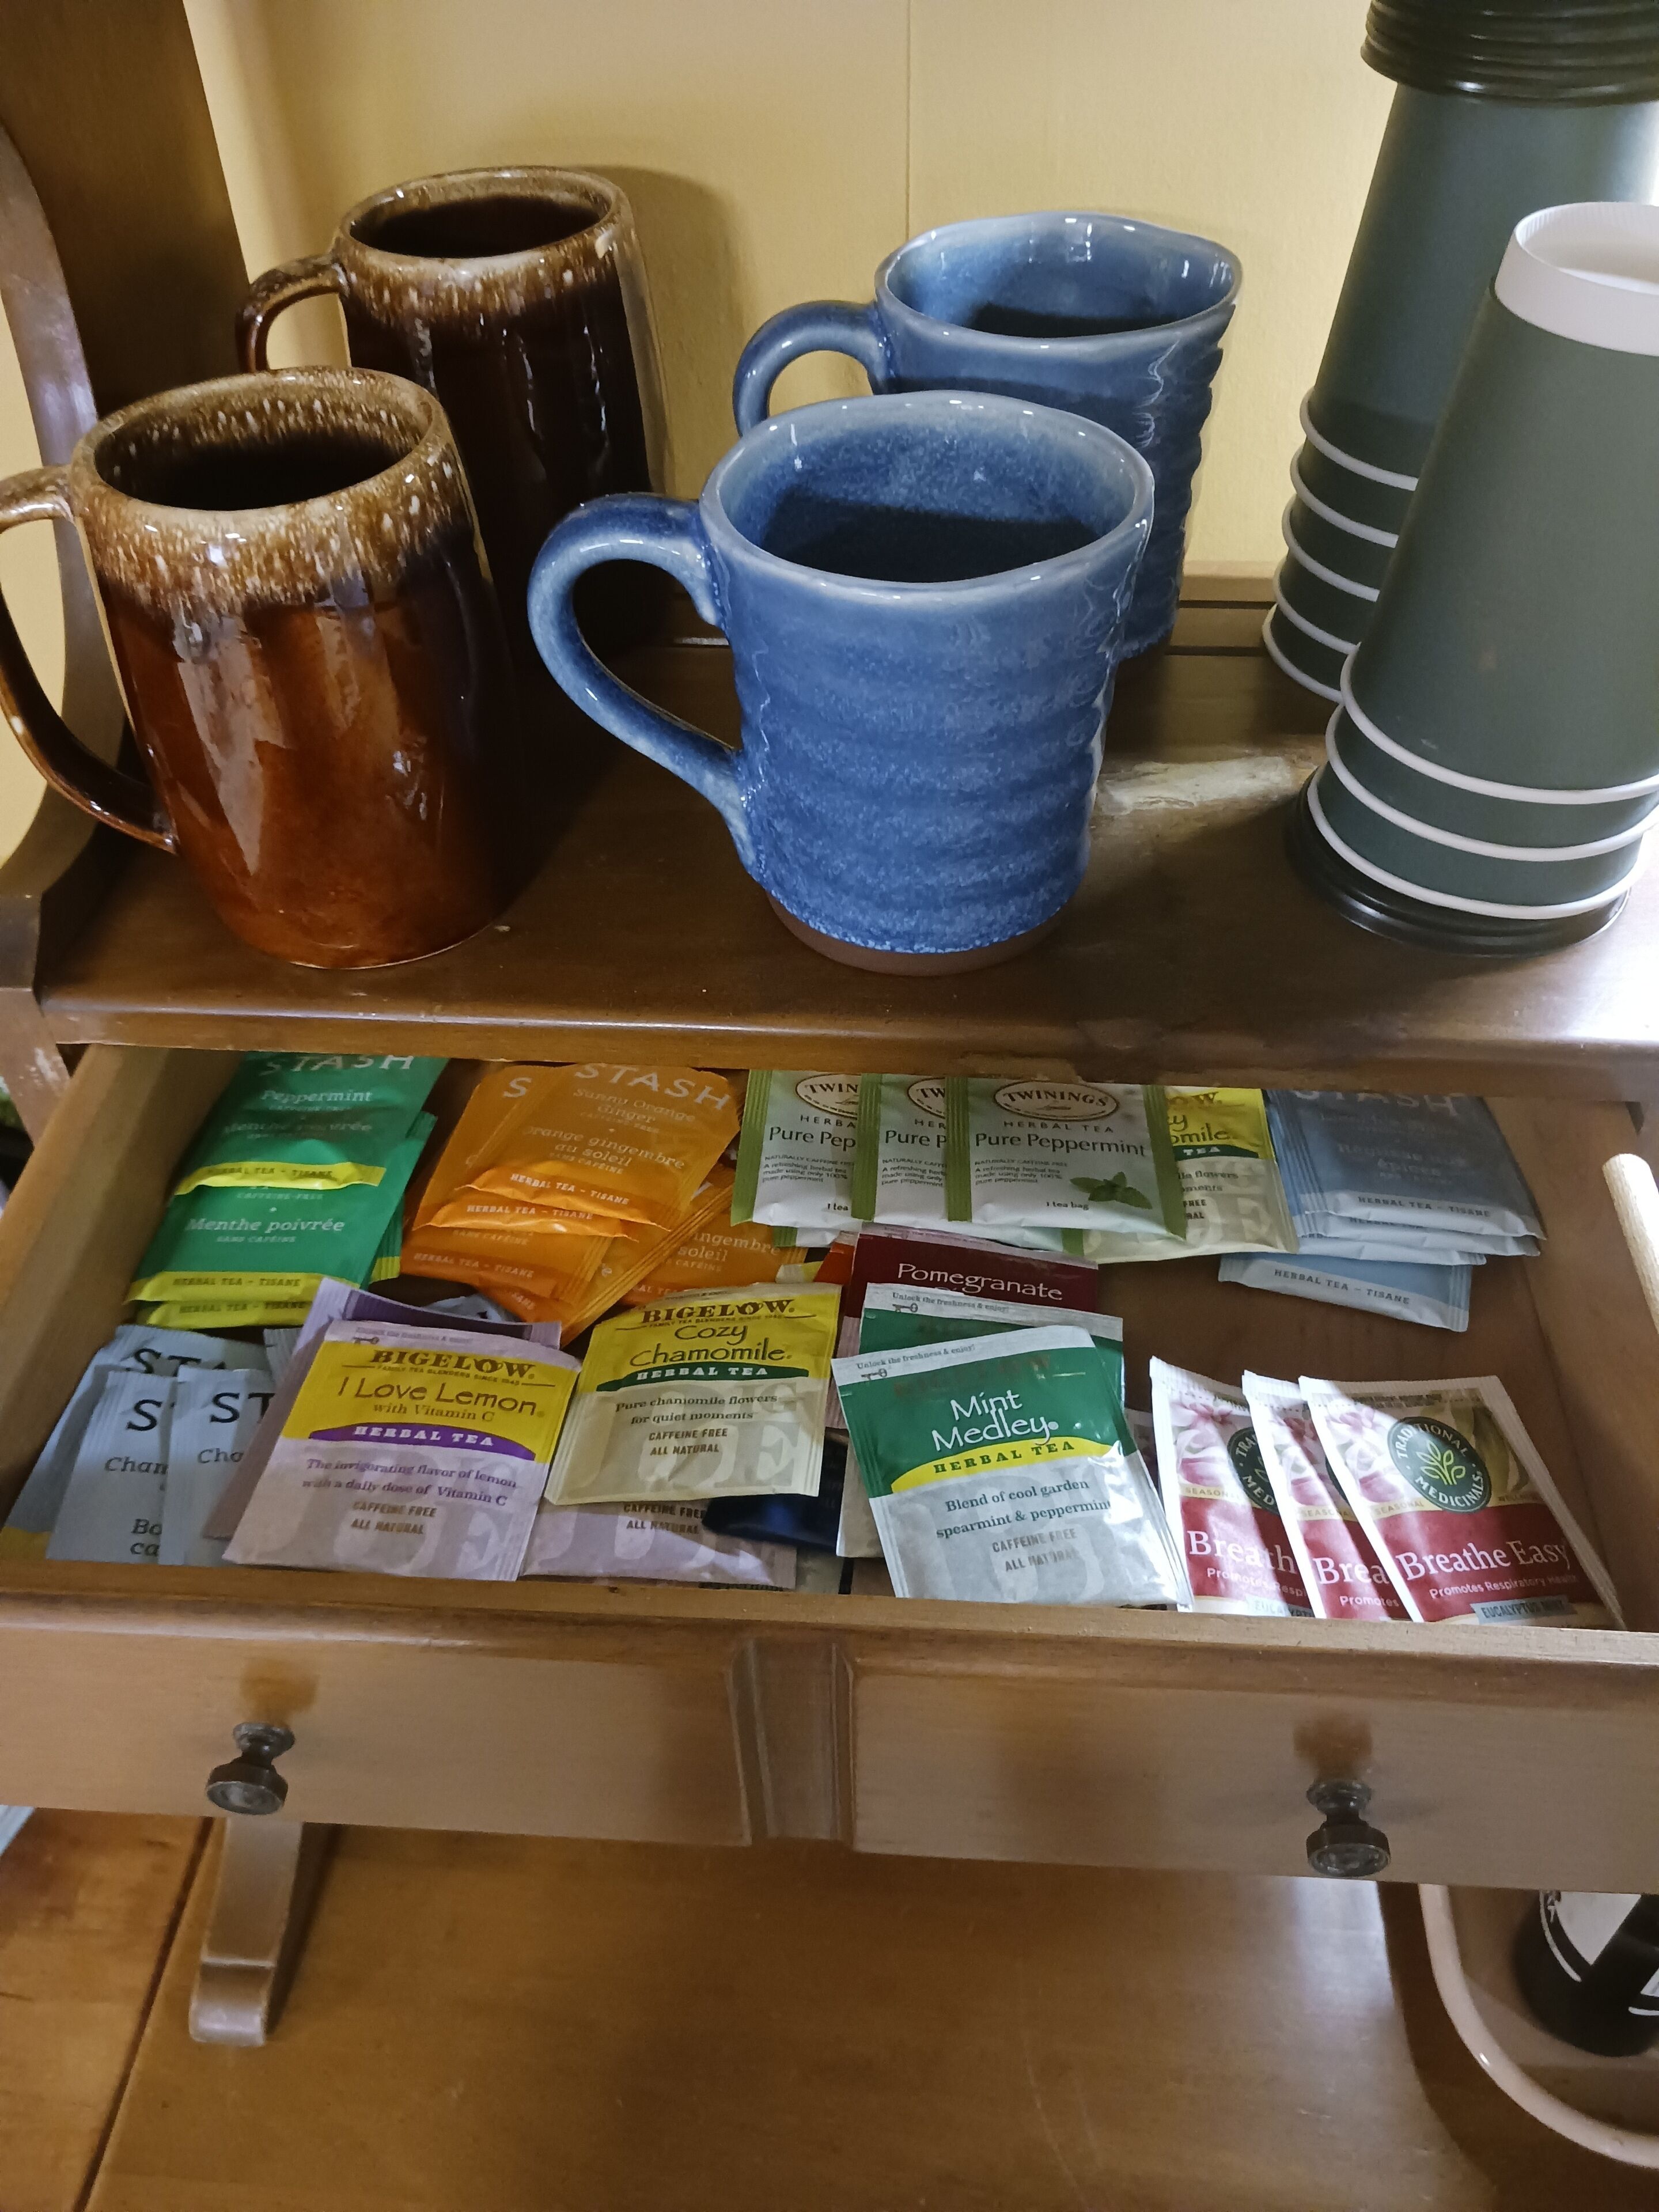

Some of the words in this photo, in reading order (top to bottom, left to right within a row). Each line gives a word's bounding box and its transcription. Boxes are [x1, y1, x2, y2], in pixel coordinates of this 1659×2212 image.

[574, 1063, 731, 1110] STASH
[805, 1083, 858, 1093] TWIN
[1003, 1090, 1109, 1106] TWININGS
[597, 1105, 656, 1123] Ginger
[634, 1100, 696, 1123] Orange
[801, 1115, 856, 1128] HERBA
[915, 1119, 946, 1130] HER
[1004, 1121, 1072, 1130] HERBAL
[1082, 1124, 1113, 1133] TEA
[769, 1127, 814, 1143] Pure
[886, 1130, 930, 1146] Pure
[589, 1137, 685, 1170] gingembre
[976, 1133, 1021, 1146] Pure
[1028, 1133, 1145, 1157] Peppermint
[1183, 1146, 1220, 1156] TEA
[555, 1142, 577, 1153] au
[582, 1148, 632, 1166] soleil
[891, 1166, 926, 1174] refreshing
[1195, 1171, 1238, 1179] flowers
[510, 1173, 550, 1189] HERBAL
[556, 1182, 575, 1192] TEA
[590, 1190, 630, 1205] TISANE
[901, 1179, 943, 1187] peppermint
[1071, 1201, 1089, 1210] bag
[1183, 1199, 1207, 1207] FREE
[1358, 1196, 1403, 1206] HERBAL
[1411, 1202, 1432, 1210] TEA
[467, 1205, 510, 1214] HERBAL
[516, 1206, 535, 1215] TEA
[553, 1209, 593, 1220] TISANE
[185, 1218, 262, 1230] Menthe
[264, 1218, 344, 1233] poivrée
[693, 1233, 780, 1256] ingembre
[677, 1246, 728, 1263] soleil
[460, 1259, 479, 1267] TEA
[495, 1264, 534, 1279] TISANE
[898, 1263, 1063, 1301] Pomegranate
[1274, 1269, 1321, 1284] HERBAL
[1327, 1280, 1348, 1290] TEA
[1366, 1289, 1410, 1304] TISANE
[893, 1293, 919, 1302] Unlock
[937, 1299, 975, 1309] freshness
[675, 1325, 748, 1345] Cozy
[856, 1359, 887, 1370] Unlock
[888, 1356, 902, 1364] the
[903, 1350, 942, 1362] freshness
[637, 1367, 718, 1380] HERBAL
[728, 1367, 768, 1375] TEA
[338, 1376, 349, 1396] I
[355, 1378, 427, 1400] Love
[616, 1400, 647, 1412] Pure
[650, 1397, 726, 1406] chamomile
[729, 1395, 778, 1404] flowers
[950, 1389, 1022, 1421] Mint
[374, 1403, 407, 1414] with
[415, 1404, 476, 1419] Vitamin
[482, 1411, 495, 1422] C
[631, 1416, 650, 1425] for
[653, 1412, 686, 1423] quiet
[354, 1426, 441, 1440] HERBAL
[452, 1433, 494, 1445] TEA
[649, 1430, 698, 1441] CAFFEINE
[702, 1429, 728, 1437] FREE
[1397, 1423, 1468, 1459] TRADITIONAL
[650, 1446, 668, 1456] ALL
[673, 1444, 719, 1454] NATURAL
[933, 1450, 1022, 1474] HERBAL
[1031, 1441, 1075, 1456] TEA
[307, 1459, 329, 1469] The
[334, 1460, 414, 1475] invigorating
[417, 1465, 459, 1477] flavor
[459, 1469, 472, 1479] of
[475, 1470, 517, 1488] lemon
[346, 1479, 377, 1491] daily
[382, 1483, 412, 1494] dose
[416, 1484, 431, 1494] of
[438, 1486, 491, 1502] Vitamin
[495, 1495, 507, 1506] C
[945, 1494, 988, 1512] Blend
[992, 1491, 1005, 1503] of
[1009, 1486, 1037, 1500] cool
[1040, 1480, 1089, 1498] garden
[353, 1502, 403, 1515] CAFFEINE
[408, 1505, 437, 1517] FREE
[624, 1504, 676, 1516] CAFFEINE
[1374, 1502, 1424, 1514] SEASONAL
[351, 1519, 370, 1529] ALL
[376, 1520, 424, 1535] NATURAL
[627, 1520, 646, 1529] ALL
[651, 1522, 699, 1534] NATURAL
[936, 1514, 1012, 1539] spearmint
[1015, 1510, 1026, 1521] &
[1030, 1499, 1111, 1521] peppermint
[993, 1533, 1047, 1552] CAFFEINE
[1050, 1528, 1078, 1541] FREE
[1187, 1531, 1297, 1574] Breath
[1395, 1543, 1511, 1581] Breathe
[1506, 1540, 1570, 1570] Easy
[1005, 1558, 1026, 1572] ALL
[1312, 1557, 1390, 1584] Brea
[1429, 1582, 1484, 1599] Promotes
[1484, 1577, 1546, 1592] Respiratory
[1340, 1596, 1399, 1607] Promotes
[1481, 1602, 1537, 1619] EUCALYPTUS
